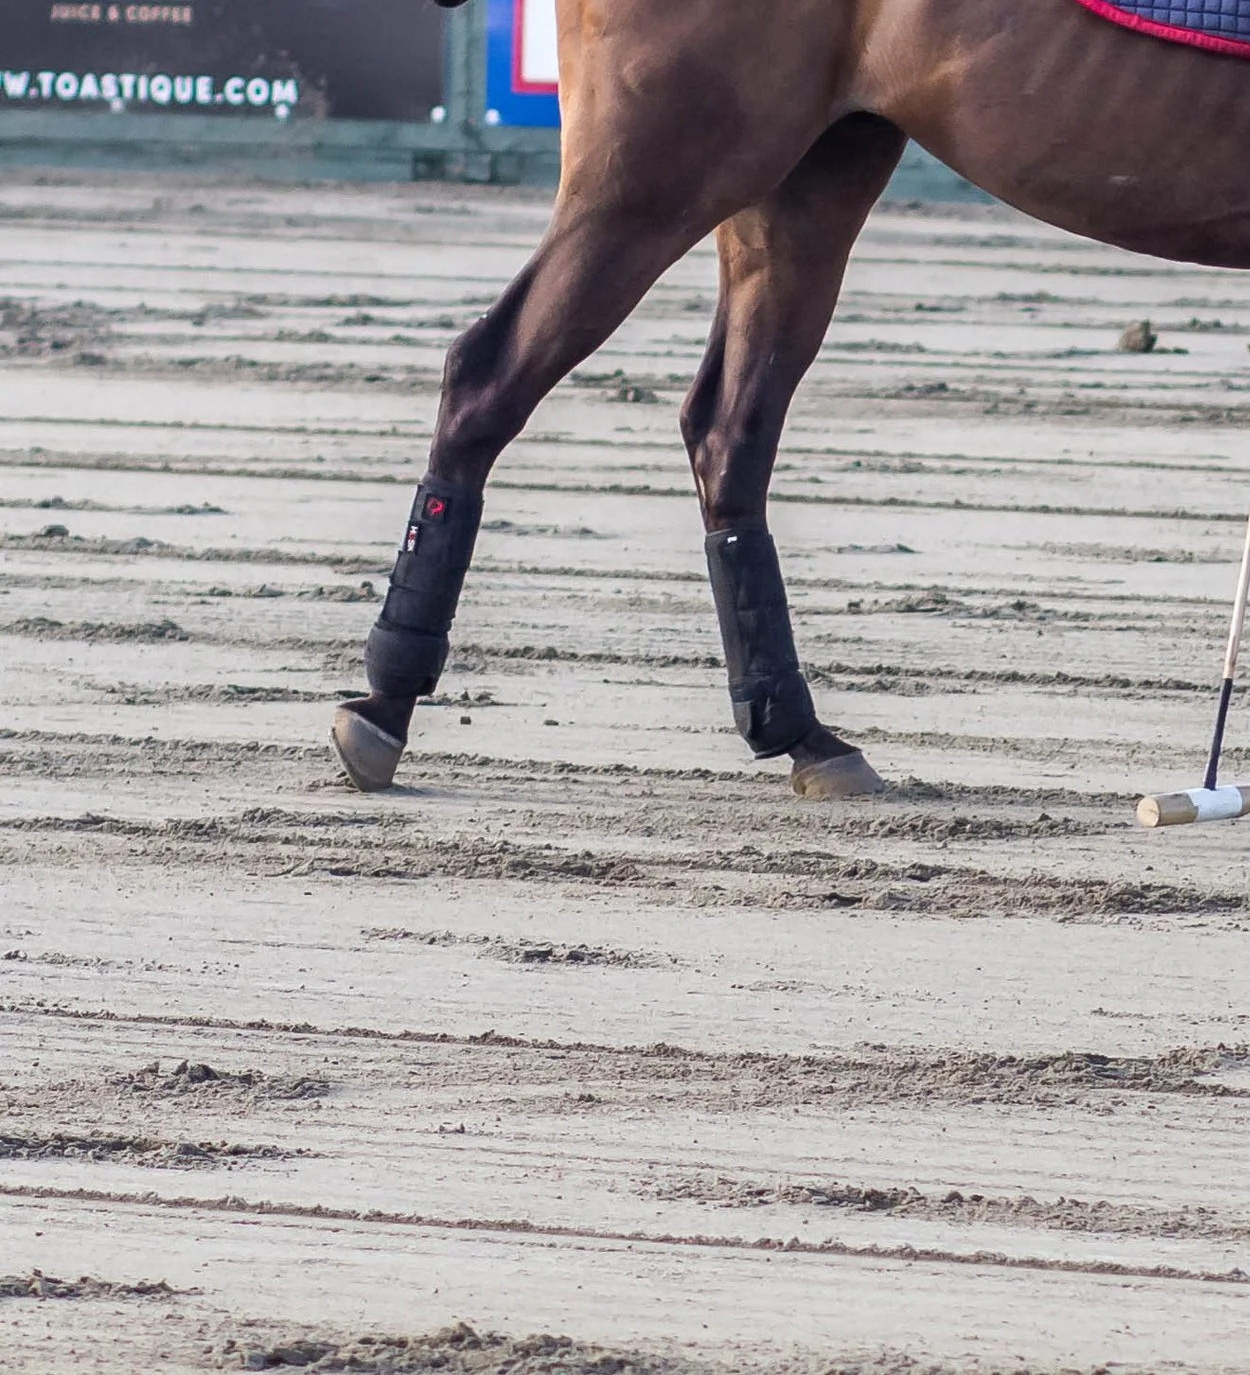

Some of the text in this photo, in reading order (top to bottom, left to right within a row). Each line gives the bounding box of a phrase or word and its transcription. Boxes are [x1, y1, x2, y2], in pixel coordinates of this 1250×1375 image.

[50, 4, 100, 20] JUICE
[126, 5, 192, 23] COFFEE
[0, 70, 298, 105] W.TOASTIQUE.COM
